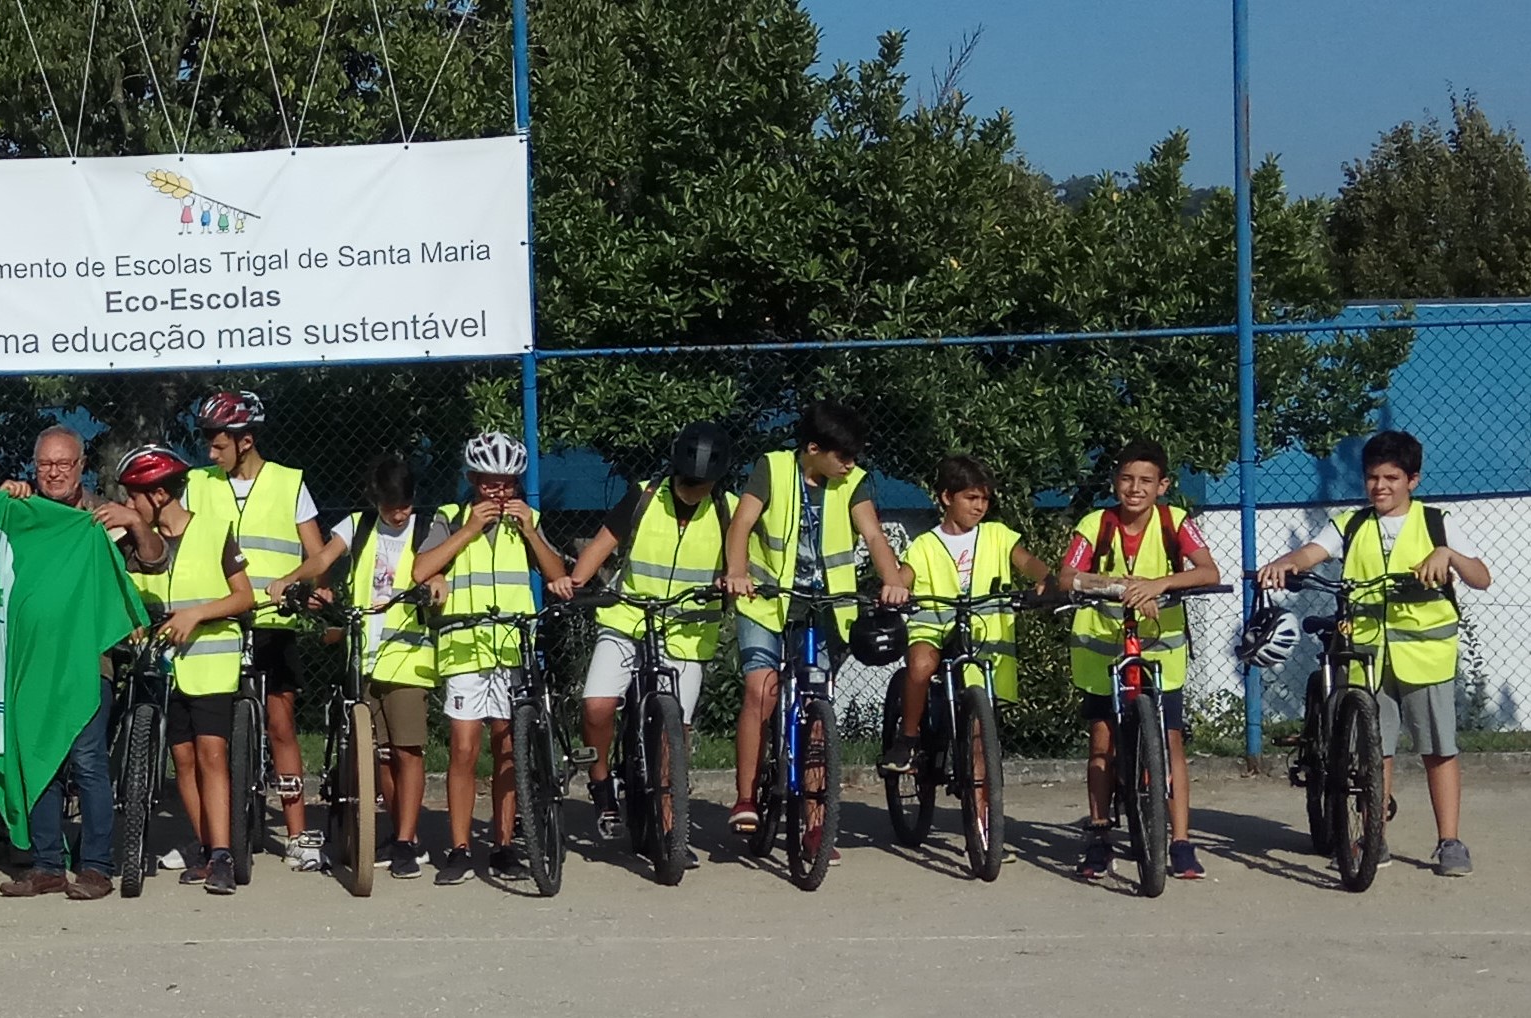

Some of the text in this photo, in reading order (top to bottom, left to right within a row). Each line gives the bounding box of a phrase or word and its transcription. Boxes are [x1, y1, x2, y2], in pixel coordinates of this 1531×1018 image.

[76, 257, 105, 277] de
[116, 254, 211, 276] Escolas
[220, 249, 288, 276] Trigal
[299, 248, 328, 268] de
[339, 245, 410, 267] Santa
[422, 240, 490, 263] Maria
[106, 286, 280, 313] Eco-Escolas
[52, 324, 205, 357] educação
[218, 320, 291, 348] mais
[304, 310, 486, 344] sustentável
